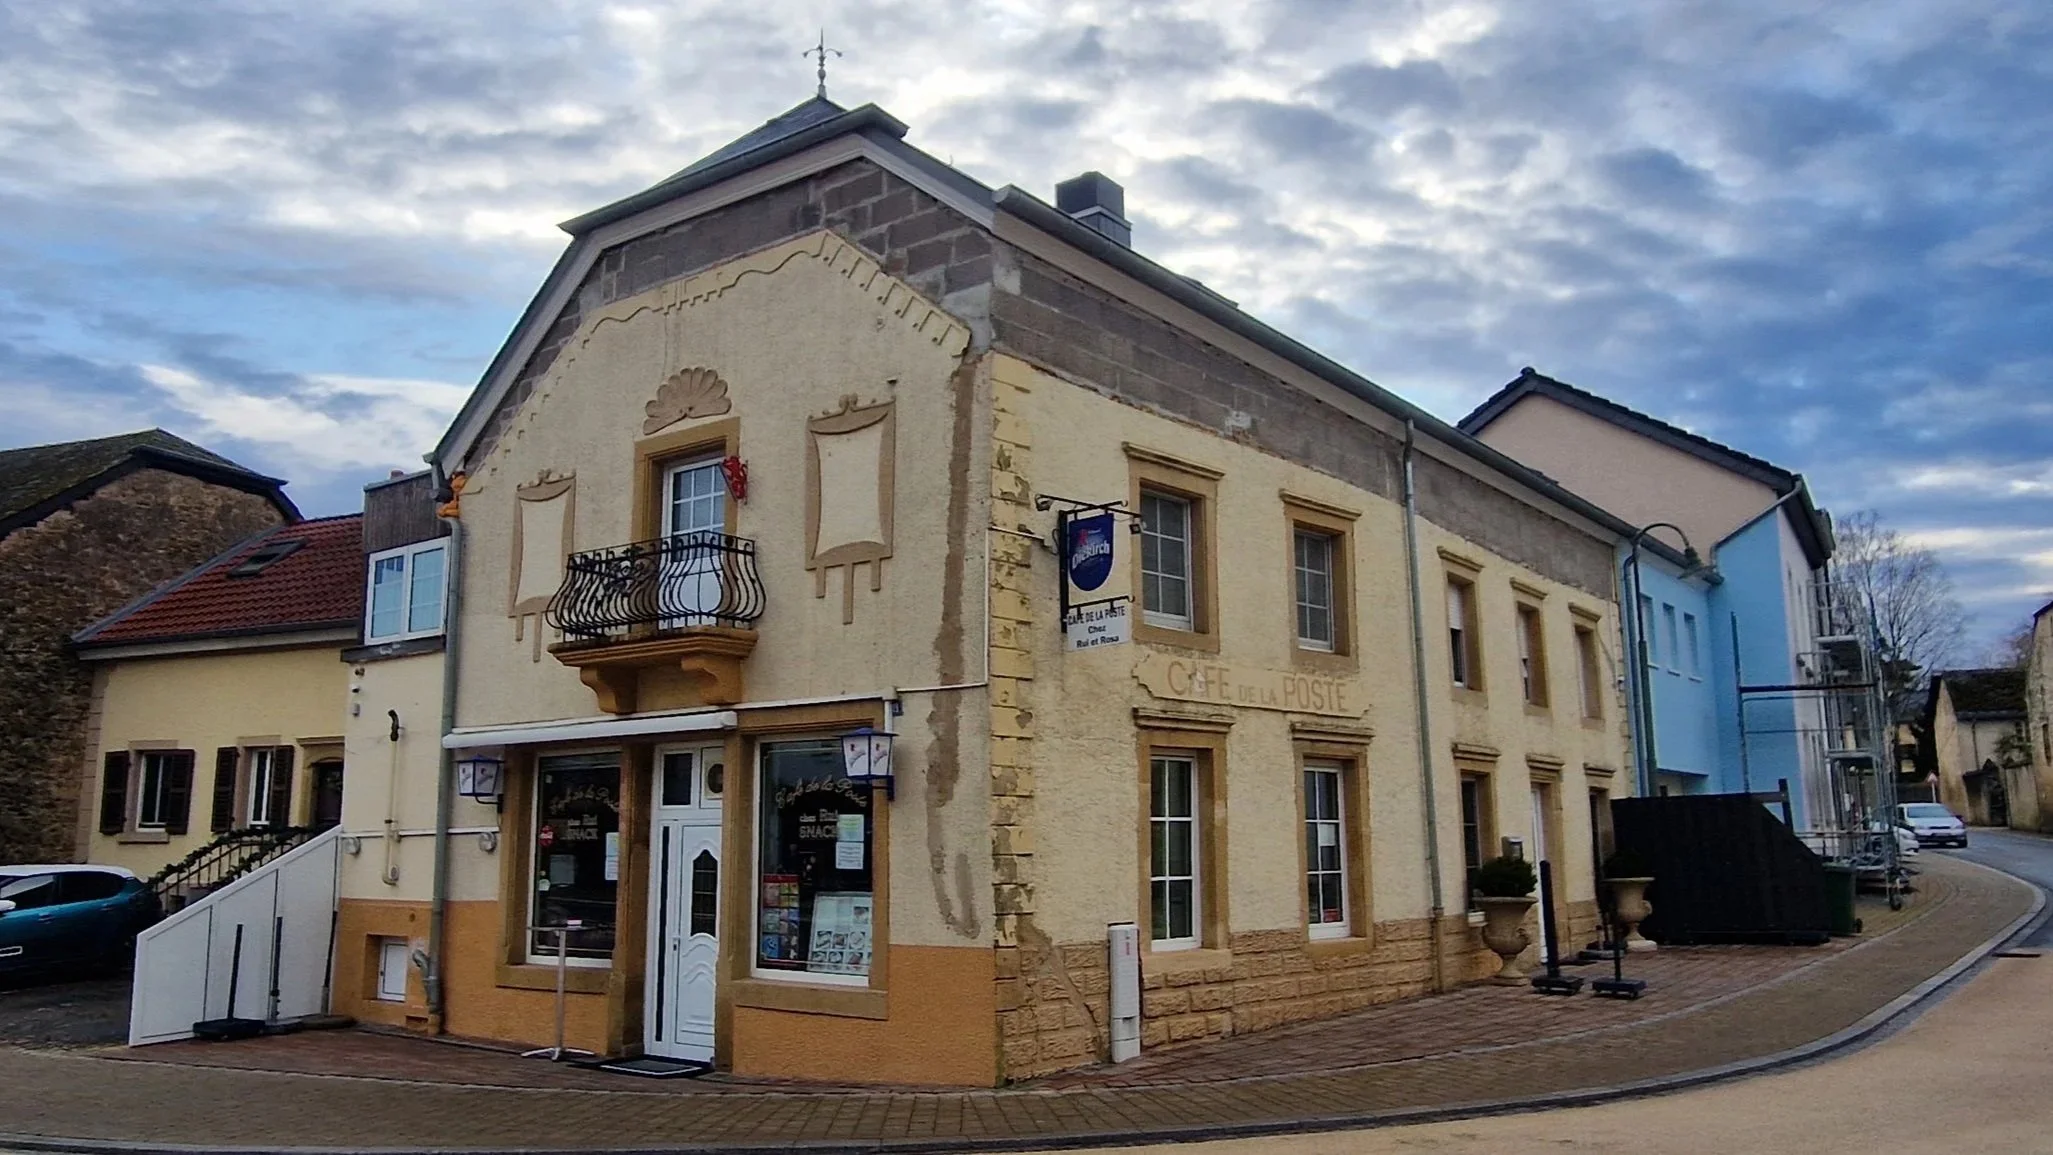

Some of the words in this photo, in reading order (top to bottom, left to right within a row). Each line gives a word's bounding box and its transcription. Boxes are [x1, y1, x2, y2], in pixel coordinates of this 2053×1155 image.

[1085, 611, 1094, 623] DE
[1095, 610, 1104, 621] LA
[1087, 625, 1106, 635] Chez
[1076, 639, 1089, 648] Rui
[1090, 638, 1099, 646] et
[1100, 636, 1119, 645] Rosa
[1238, 684, 1256, 703] DE
[1260, 687, 1278, 705] LA
[1283, 676, 1348, 712] POSTE
